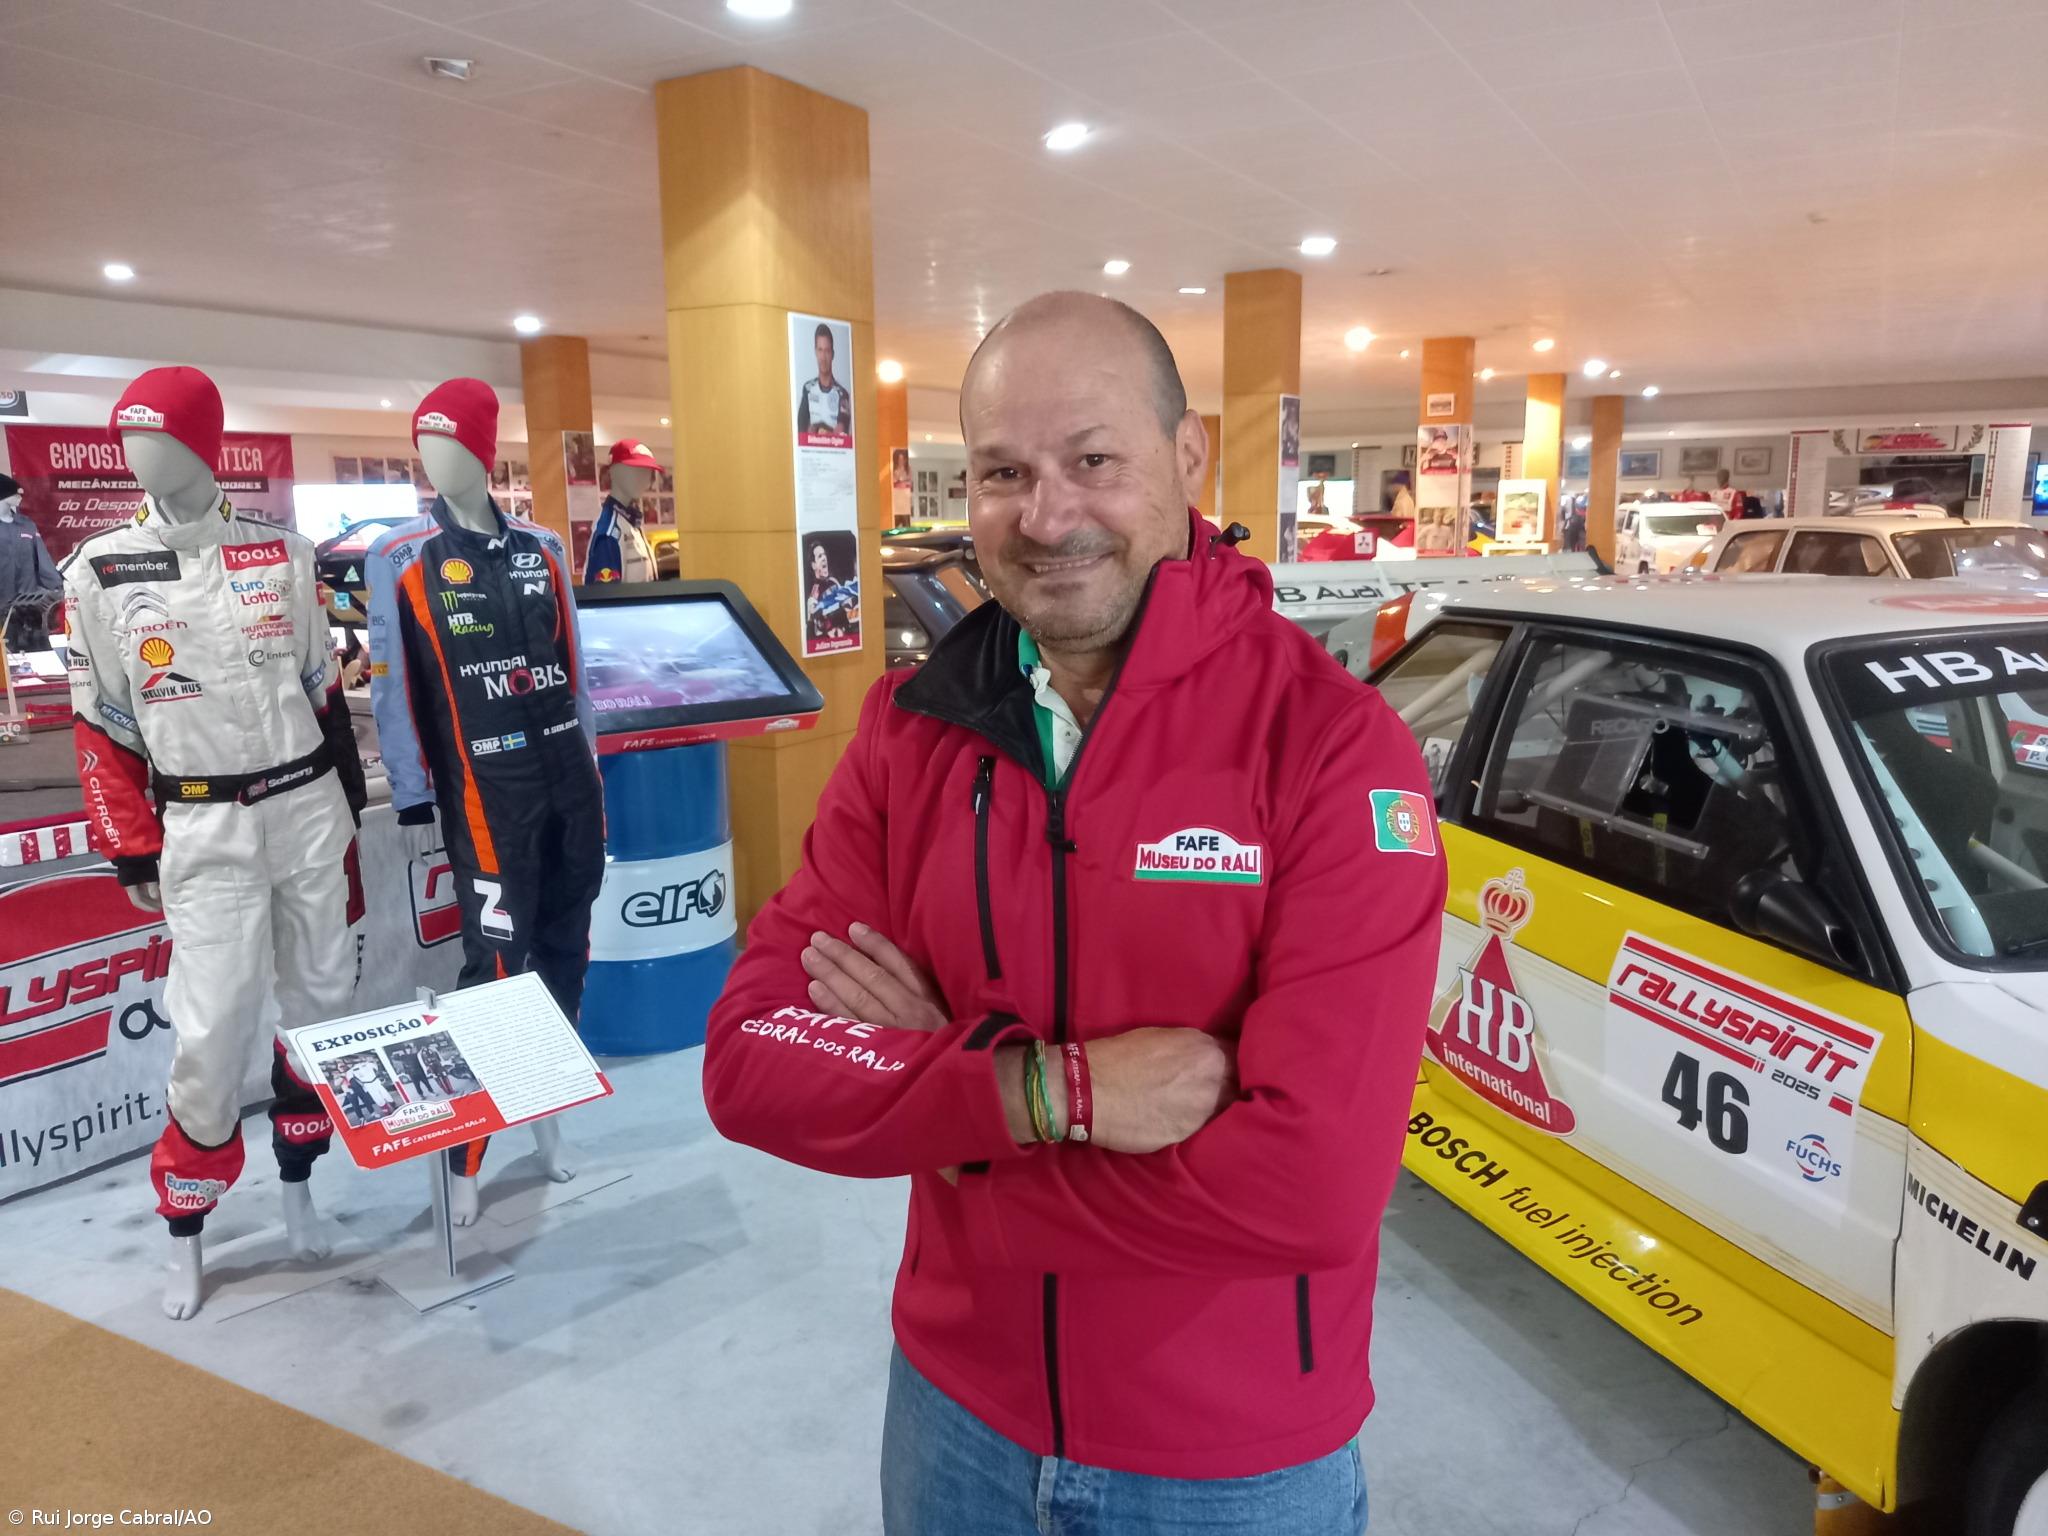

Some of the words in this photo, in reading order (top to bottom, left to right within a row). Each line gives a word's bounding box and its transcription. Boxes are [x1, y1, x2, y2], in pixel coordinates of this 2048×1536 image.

[50, 442, 134, 472] EXPOSI
[58, 499, 80, 511] do
[229, 548, 281, 563] TOOLS
[509, 568, 550, 580] HYUNDA
[231, 580, 265, 593] Euro
[1316, 585, 1384, 600] Audi
[241, 591, 279, 606] Lotto
[451, 623, 494, 638] Racing
[460, 655, 527, 677] HYUNDAI
[1864, 651, 1994, 694] HB
[482, 663, 568, 700] MOBIS
[141, 686, 176, 701] HELLVIK
[181, 683, 202, 694] HUS
[471, 741, 501, 754] OMP
[267, 765, 314, 788] Solberg
[181, 785, 208, 796] OMP
[1175, 835, 1220, 852] FAFE
[1139, 847, 1190, 870] MUSEU
[1192, 857, 1217, 870] DO
[1221, 849, 1258, 873] RALI
[621, 879, 700, 928] elf
[1456, 964, 1535, 1073] HB
[312, 1018, 422, 1053] EXPOSIÇÃO
[813, 1037, 845, 1057] DOS
[1442, 1041, 1551, 1125] international
[1771, 1068, 1821, 1101] 2025
[403, 1104, 425, 1116] FAFE
[417, 1112, 429, 1121] DO
[430, 1103, 448, 1115] RALI
[1661, 1051, 1750, 1154] 46
[282, 1118, 331, 1136] TOOLS
[371, 1136, 413, 1157] FAFE
[412, 1128, 453, 1144] CATEDRAL
[1785, 1139, 1842, 1178] FUCHS
[166, 1174, 199, 1192] Euro
[169, 1192, 207, 1207] Lotto
[1407, 1111, 1509, 1188] BOSCH
[1498, 1185, 1568, 1230] fuel
[1555, 1223, 1704, 1327] injection
[1907, 1171, 2037, 1281] MICHELIN
